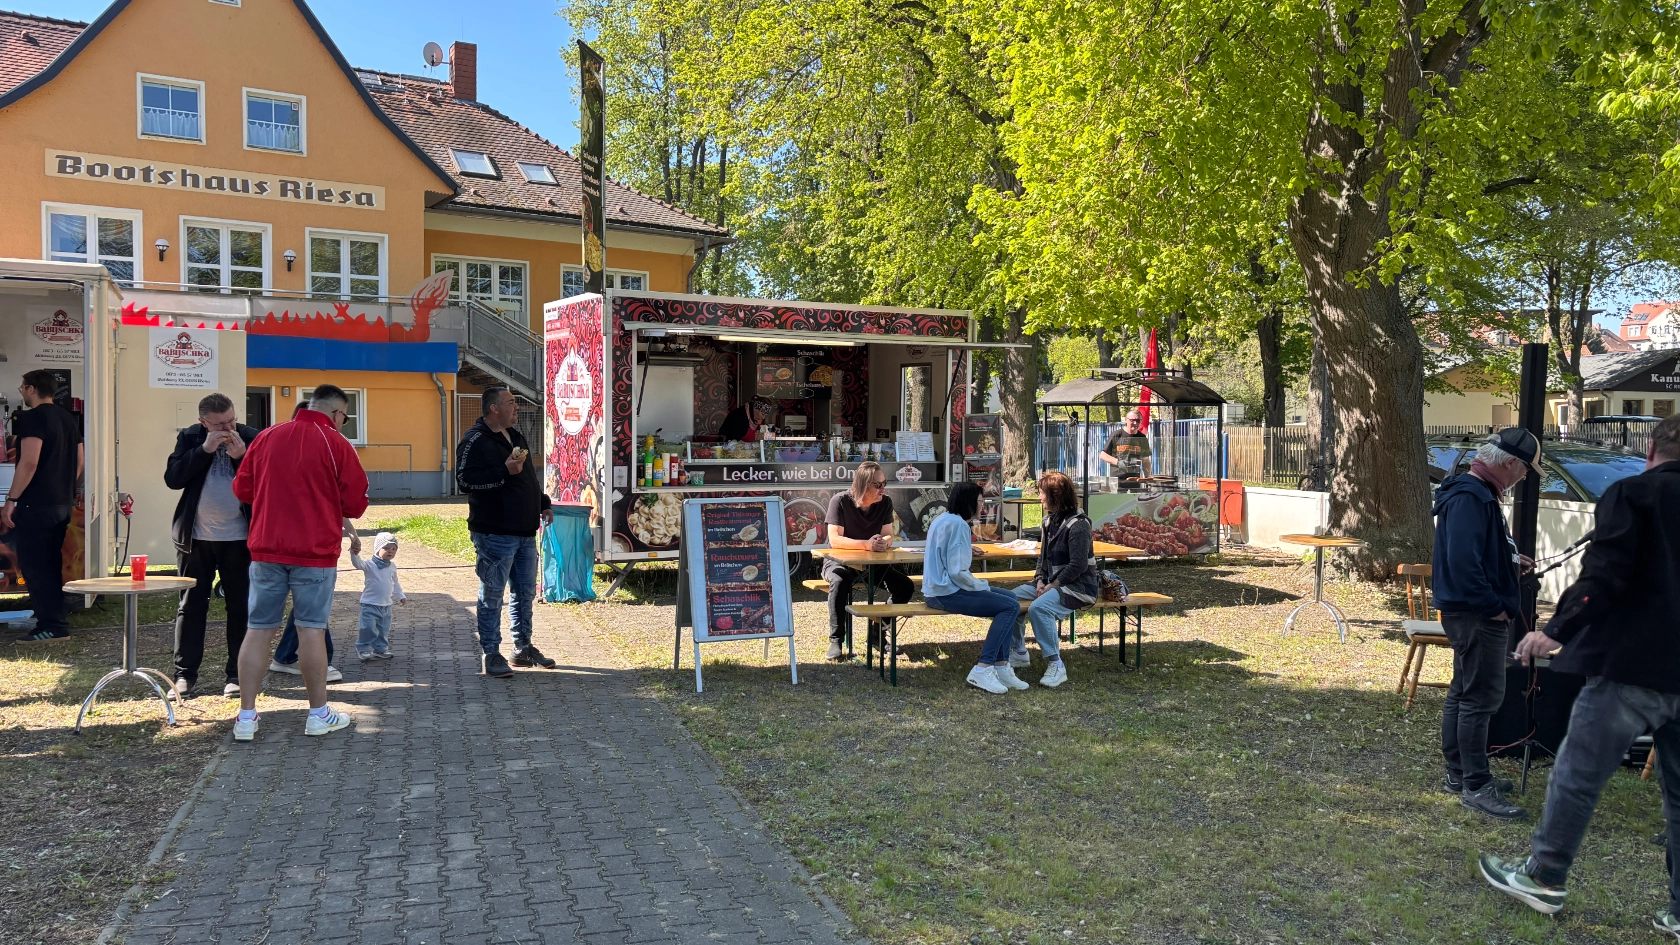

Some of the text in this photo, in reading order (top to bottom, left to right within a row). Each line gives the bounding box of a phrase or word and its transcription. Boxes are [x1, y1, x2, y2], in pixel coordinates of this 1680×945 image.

[54, 155, 377, 207] Bootshaus Riesa
[723, 465, 857, 481] Lecker, wie bei Om
[710, 553, 758, 562] Rauchwurst
[713, 593, 761, 603] Schaschlik
